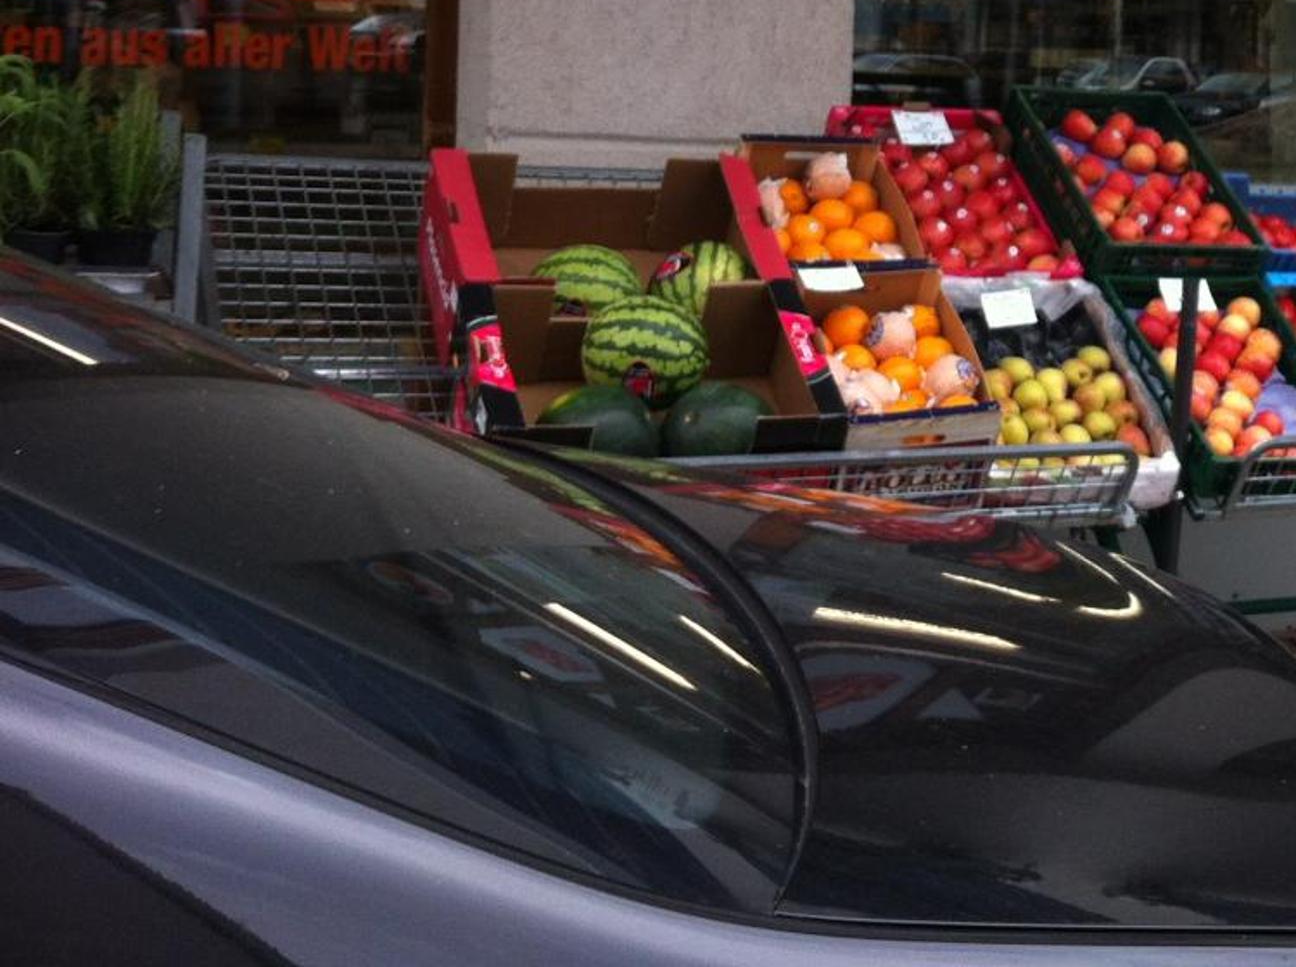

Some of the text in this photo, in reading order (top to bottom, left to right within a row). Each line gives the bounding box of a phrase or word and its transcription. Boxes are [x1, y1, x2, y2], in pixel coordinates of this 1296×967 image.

[83, 27, 170, 67] aus
[184, 22, 289, 70] aller
[310, 25, 412, 72] Welt
